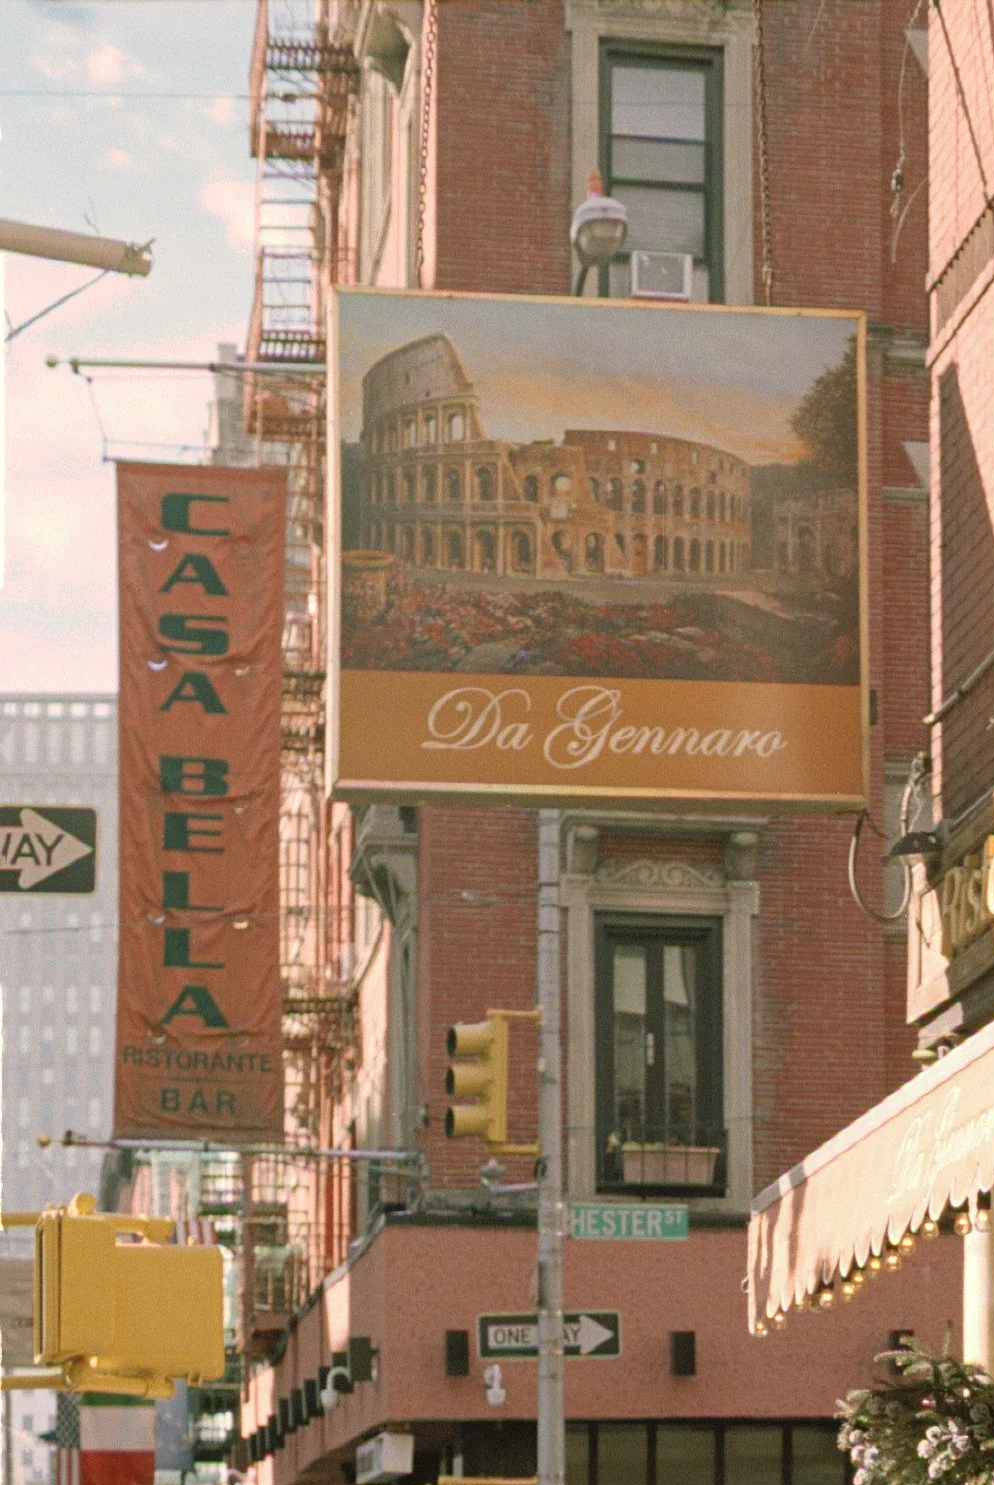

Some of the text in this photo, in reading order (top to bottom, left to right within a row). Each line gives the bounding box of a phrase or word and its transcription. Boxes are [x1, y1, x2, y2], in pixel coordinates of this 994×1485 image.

[421, 685, 788, 770] Da Gennaro
[157, 492, 231, 1029] CASA BELLA
[122, 1045, 274, 1074] RISTORANTE
[160, 1086, 236, 1115] BAR
[569, 1209, 687, 1237] HESTER ST
[493, 1328, 532, 1345] ONE
